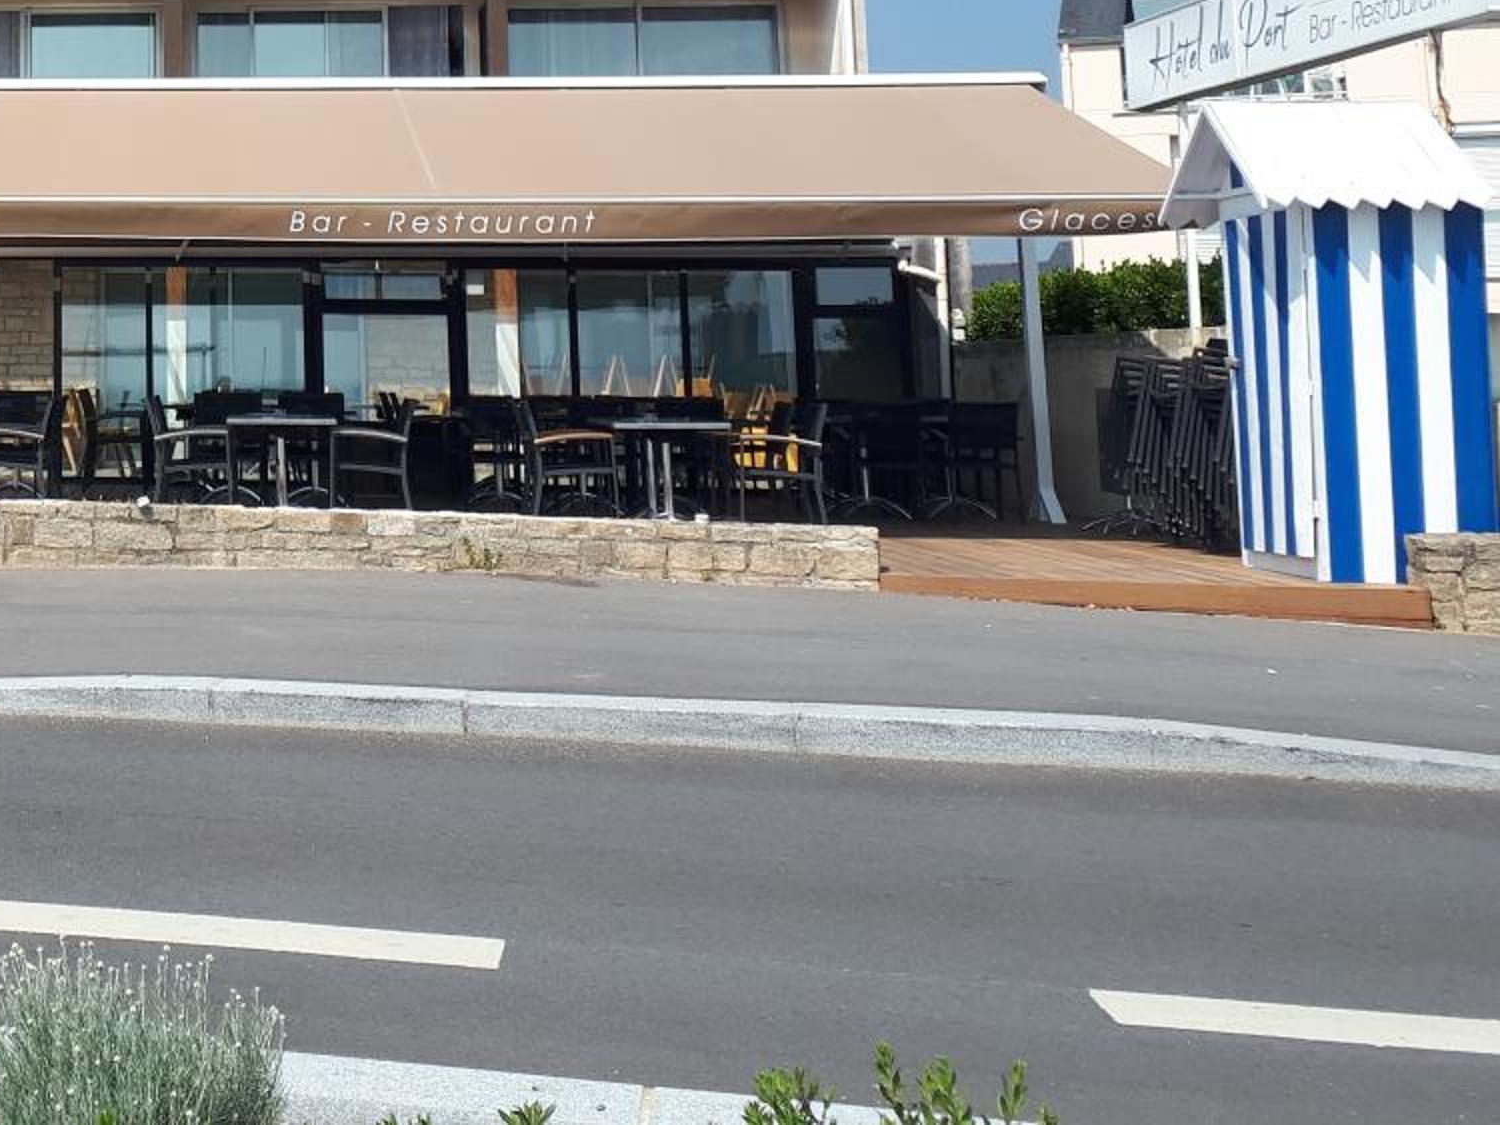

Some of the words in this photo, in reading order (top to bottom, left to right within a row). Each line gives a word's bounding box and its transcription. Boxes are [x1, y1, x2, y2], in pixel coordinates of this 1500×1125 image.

[1308, 13, 1338, 44] Bar
[290, 209, 348, 234] Bar
[387, 209, 597, 234] Restaurant
[1018, 207, 1157, 232] Glaces
